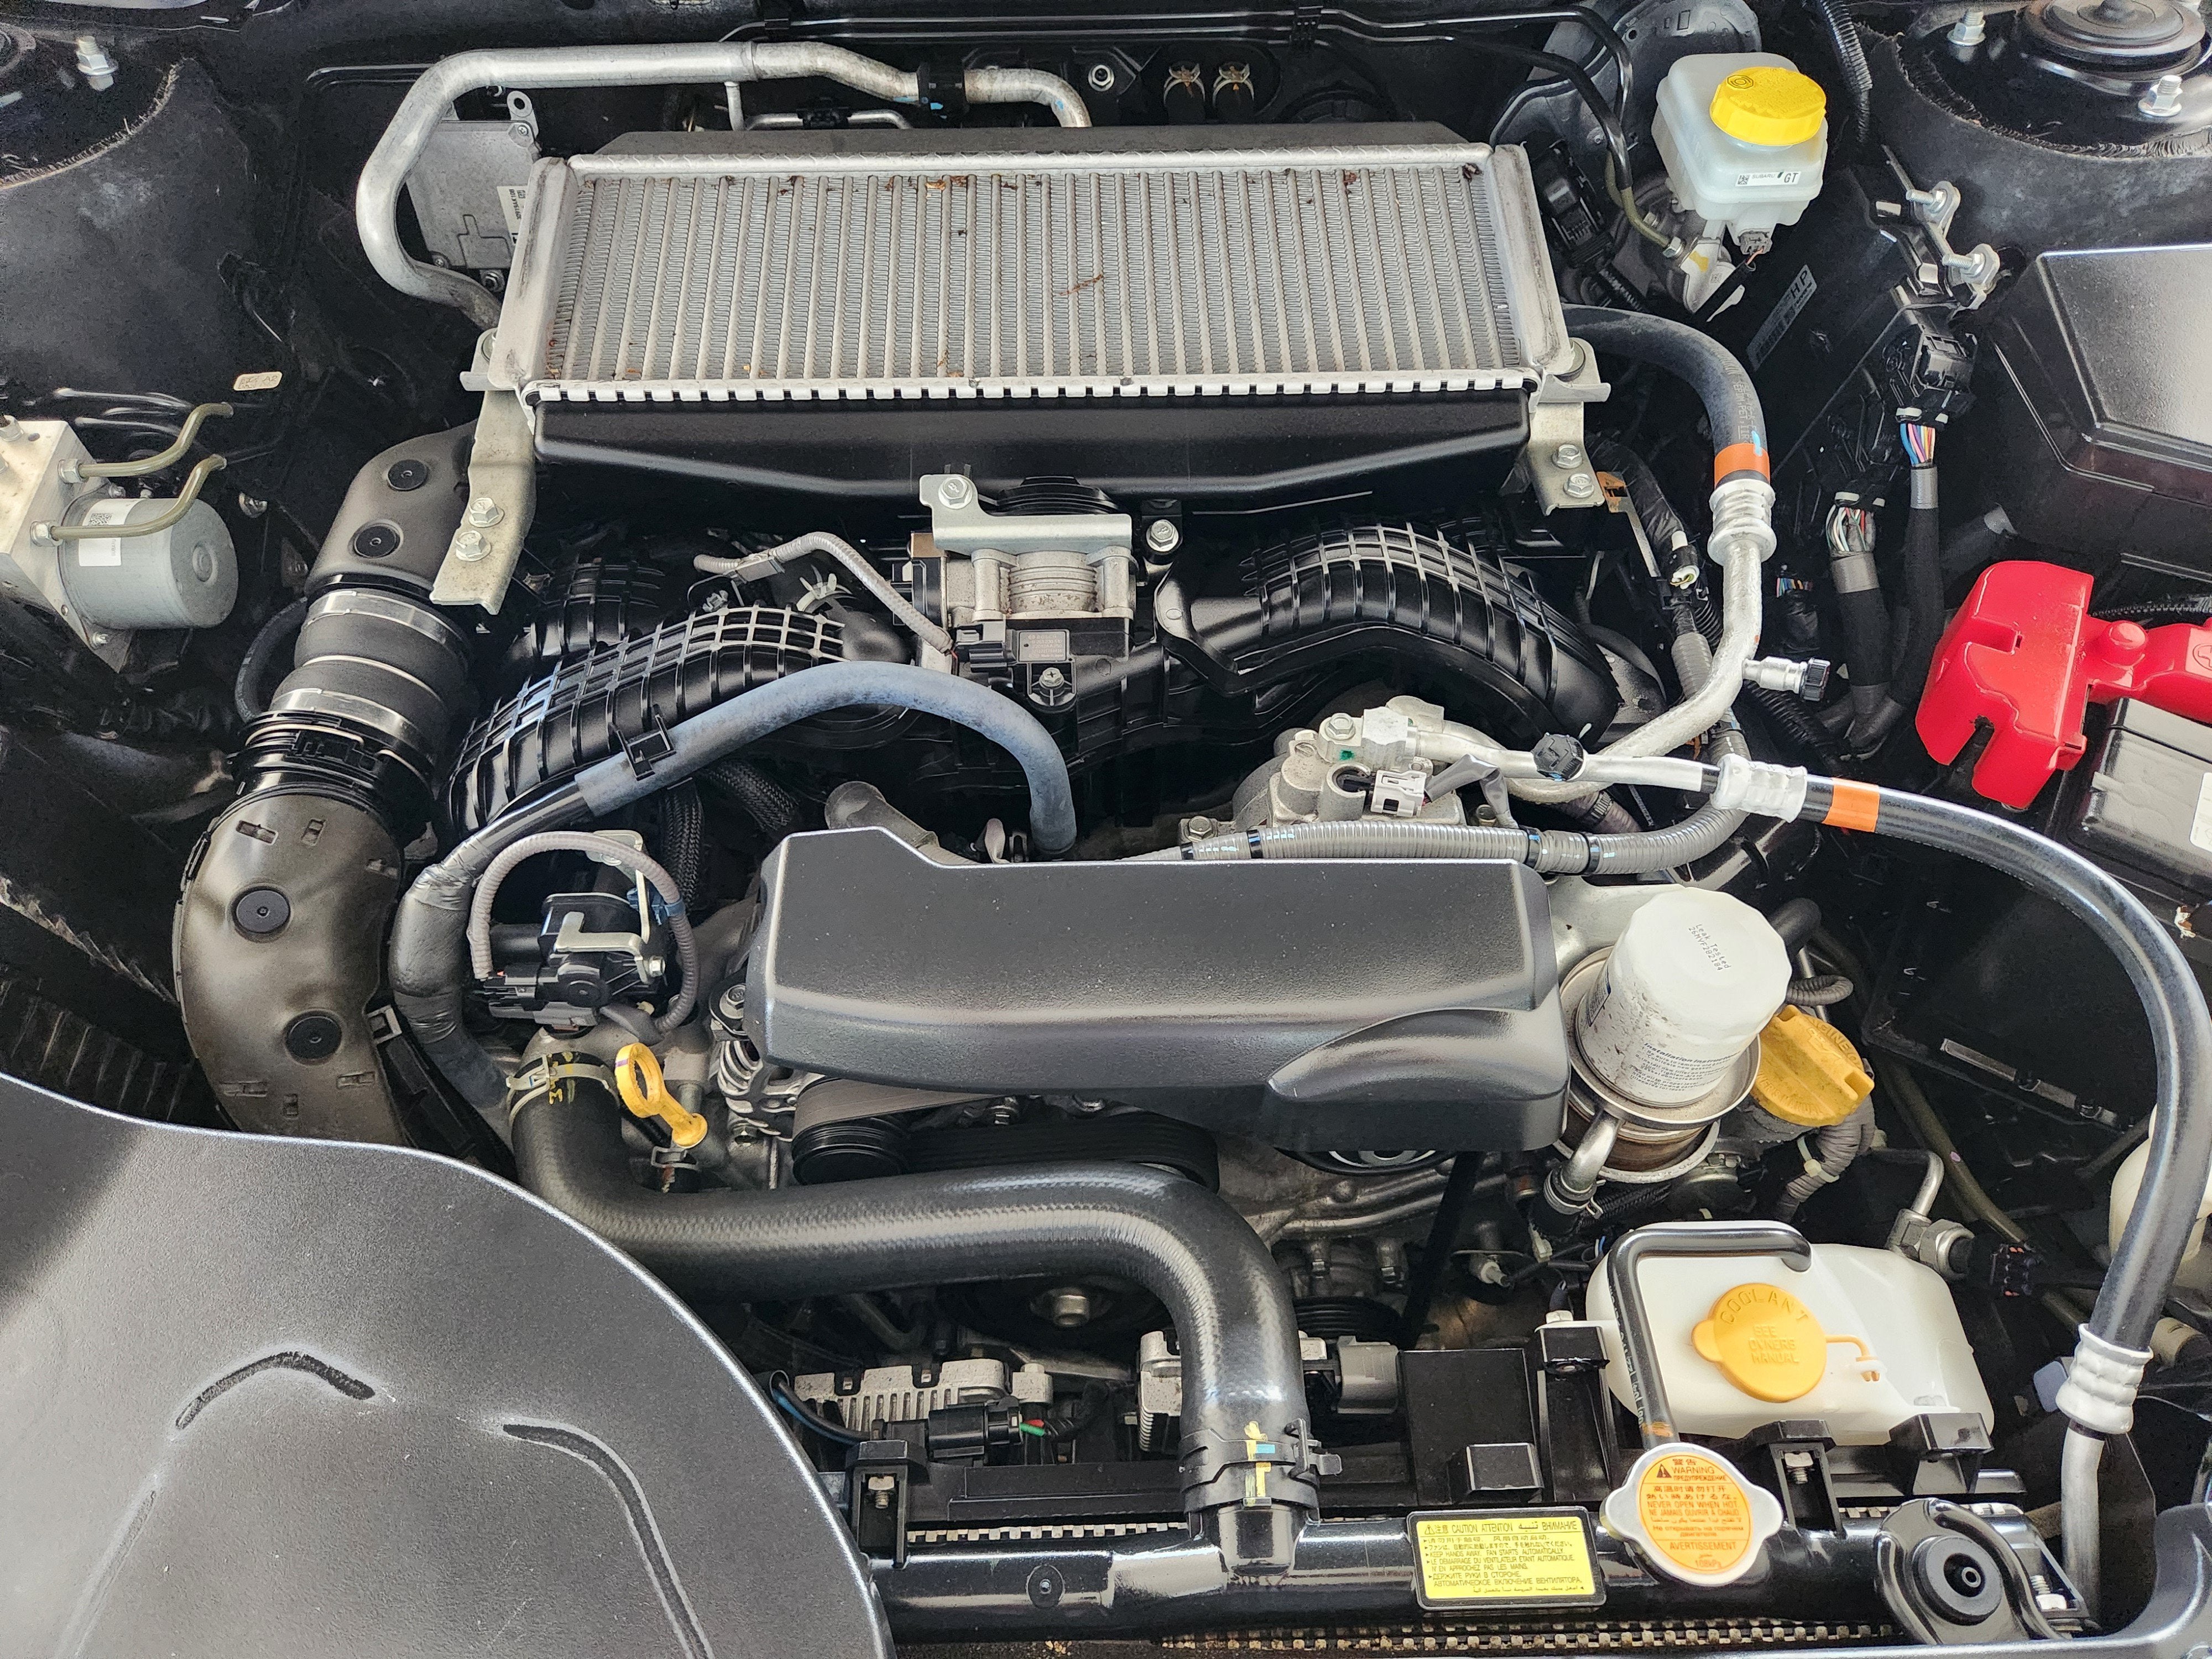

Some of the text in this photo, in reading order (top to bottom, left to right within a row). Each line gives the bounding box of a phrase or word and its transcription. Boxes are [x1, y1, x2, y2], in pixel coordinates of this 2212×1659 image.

[1784, 173, 1799, 183] GT
[1791, 270, 1808, 298] HP
[1695, 924, 1731, 969] Leak Tested
[1644, 1043, 1693, 1062] Installation
[1720, 1288, 1809, 1324] COOLANT
[1754, 1325, 1777, 1338] SEE
[1751, 1352, 1799, 1364] MANUAL
[1452, 1523, 1513, 1533] CAUTION ATTENTION
[1542, 1521, 1578, 1531] ВНИМАНИЕ
[1670, 1542, 1736, 1550] AVERTISSEMENT
